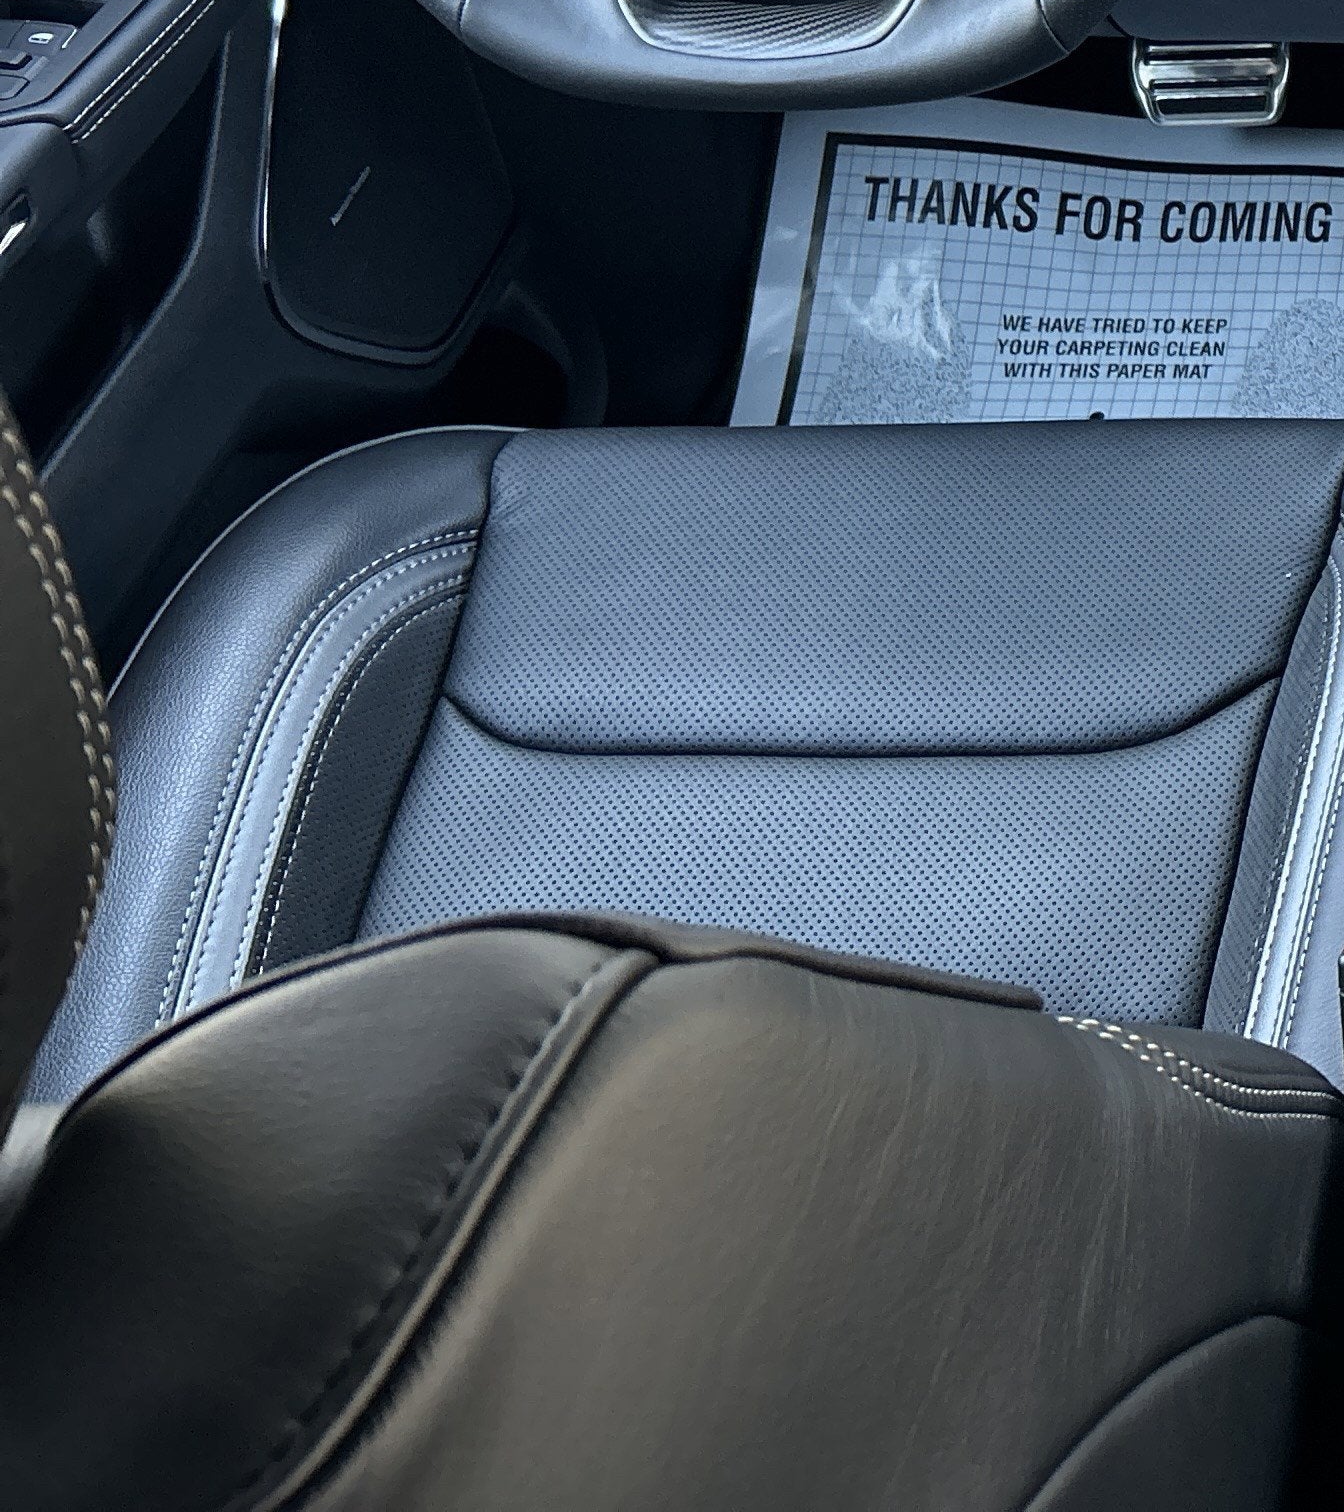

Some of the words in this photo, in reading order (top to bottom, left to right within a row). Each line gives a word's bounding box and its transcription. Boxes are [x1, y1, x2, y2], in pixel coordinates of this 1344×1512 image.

[865, 175, 1040, 233] THANKS
[1055, 190, 1145, 243] FOR
[1160, 200, 1333, 244] COMING
[1002, 314, 1033, 332] WE
[1037, 316, 1086, 333] HAVE
[1092, 317, 1145, 334] TRIED
[1152, 318, 1176, 334] TO
[1181, 318, 1228, 335] KEEP
[996, 337, 1049, 356] YOUR
[1055, 339, 1160, 357] CARPETING
[1166, 340, 1226, 357] CLEAN
[1003, 362, 1050, 378] WITH
[1059, 362, 1100, 379] THIS
[1106, 363, 1167, 379] PAPER
[1172, 364, 1213, 379] MAT
